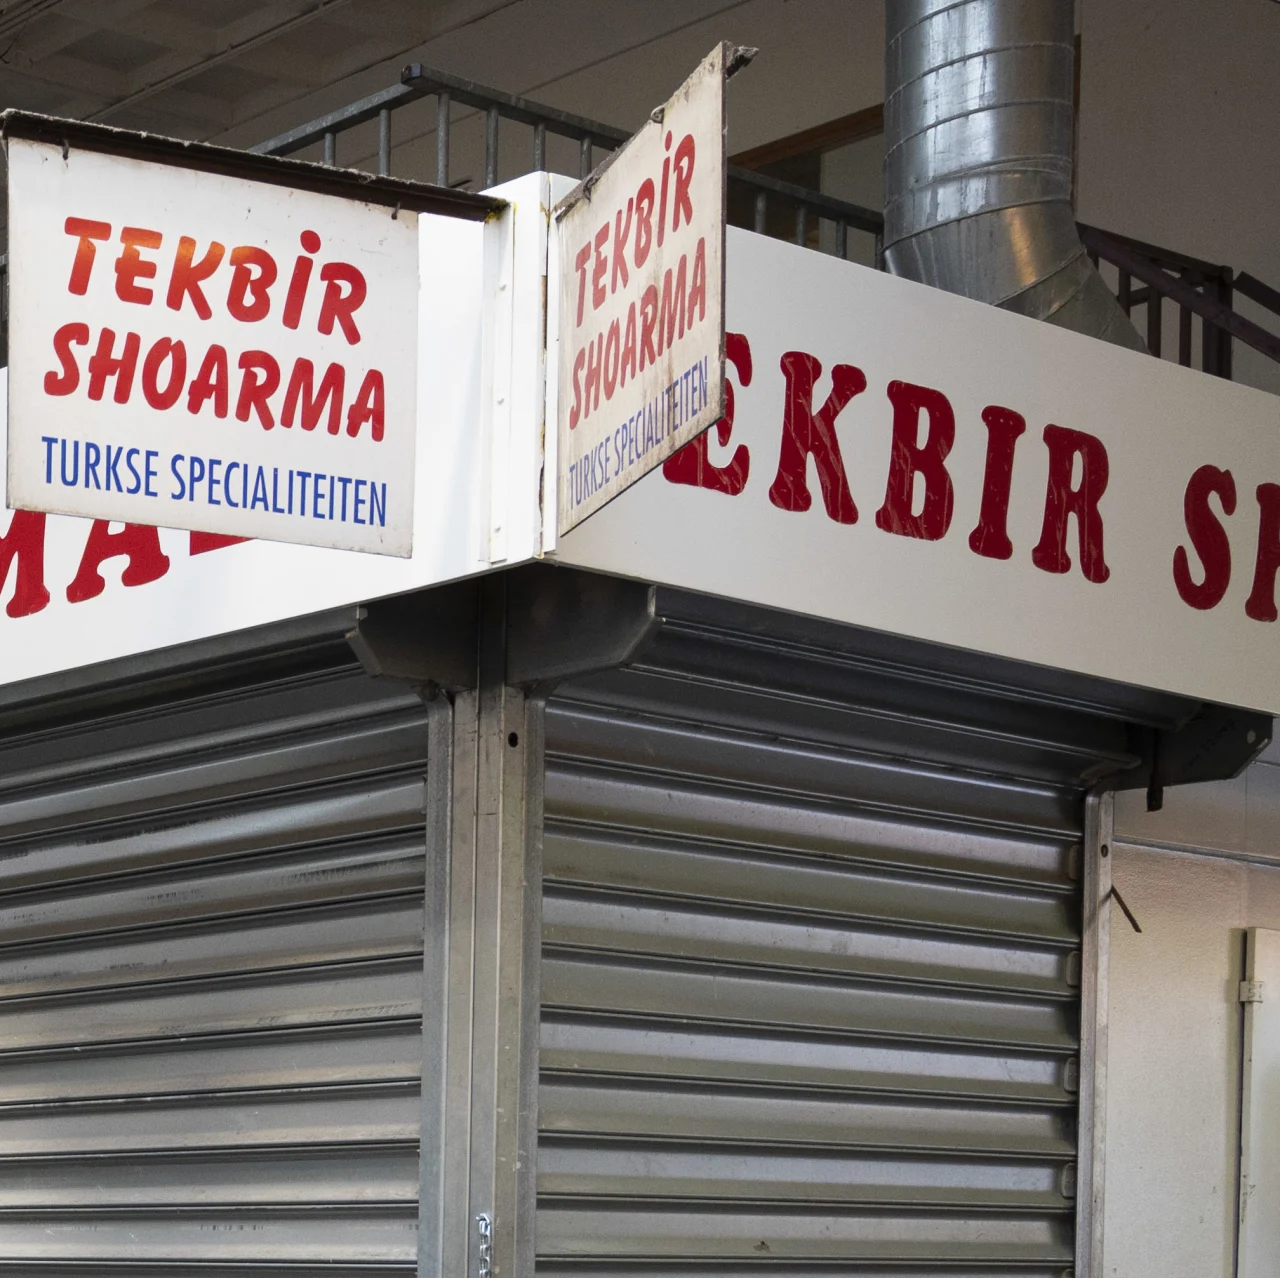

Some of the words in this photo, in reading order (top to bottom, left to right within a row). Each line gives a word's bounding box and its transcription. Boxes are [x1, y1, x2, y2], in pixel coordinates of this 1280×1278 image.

[43, 322, 386, 443] SHOARMA
[569, 236, 706, 430] SHOARMA
[41, 436, 158, 497] TURKSE
[170, 453, 387, 527] SPECIALITEITEN
[569, 437, 610, 510] TURKSE
[614, 356, 708, 476] SPECIALITEITEN
[662, 332, 1111, 584] EKBIR
